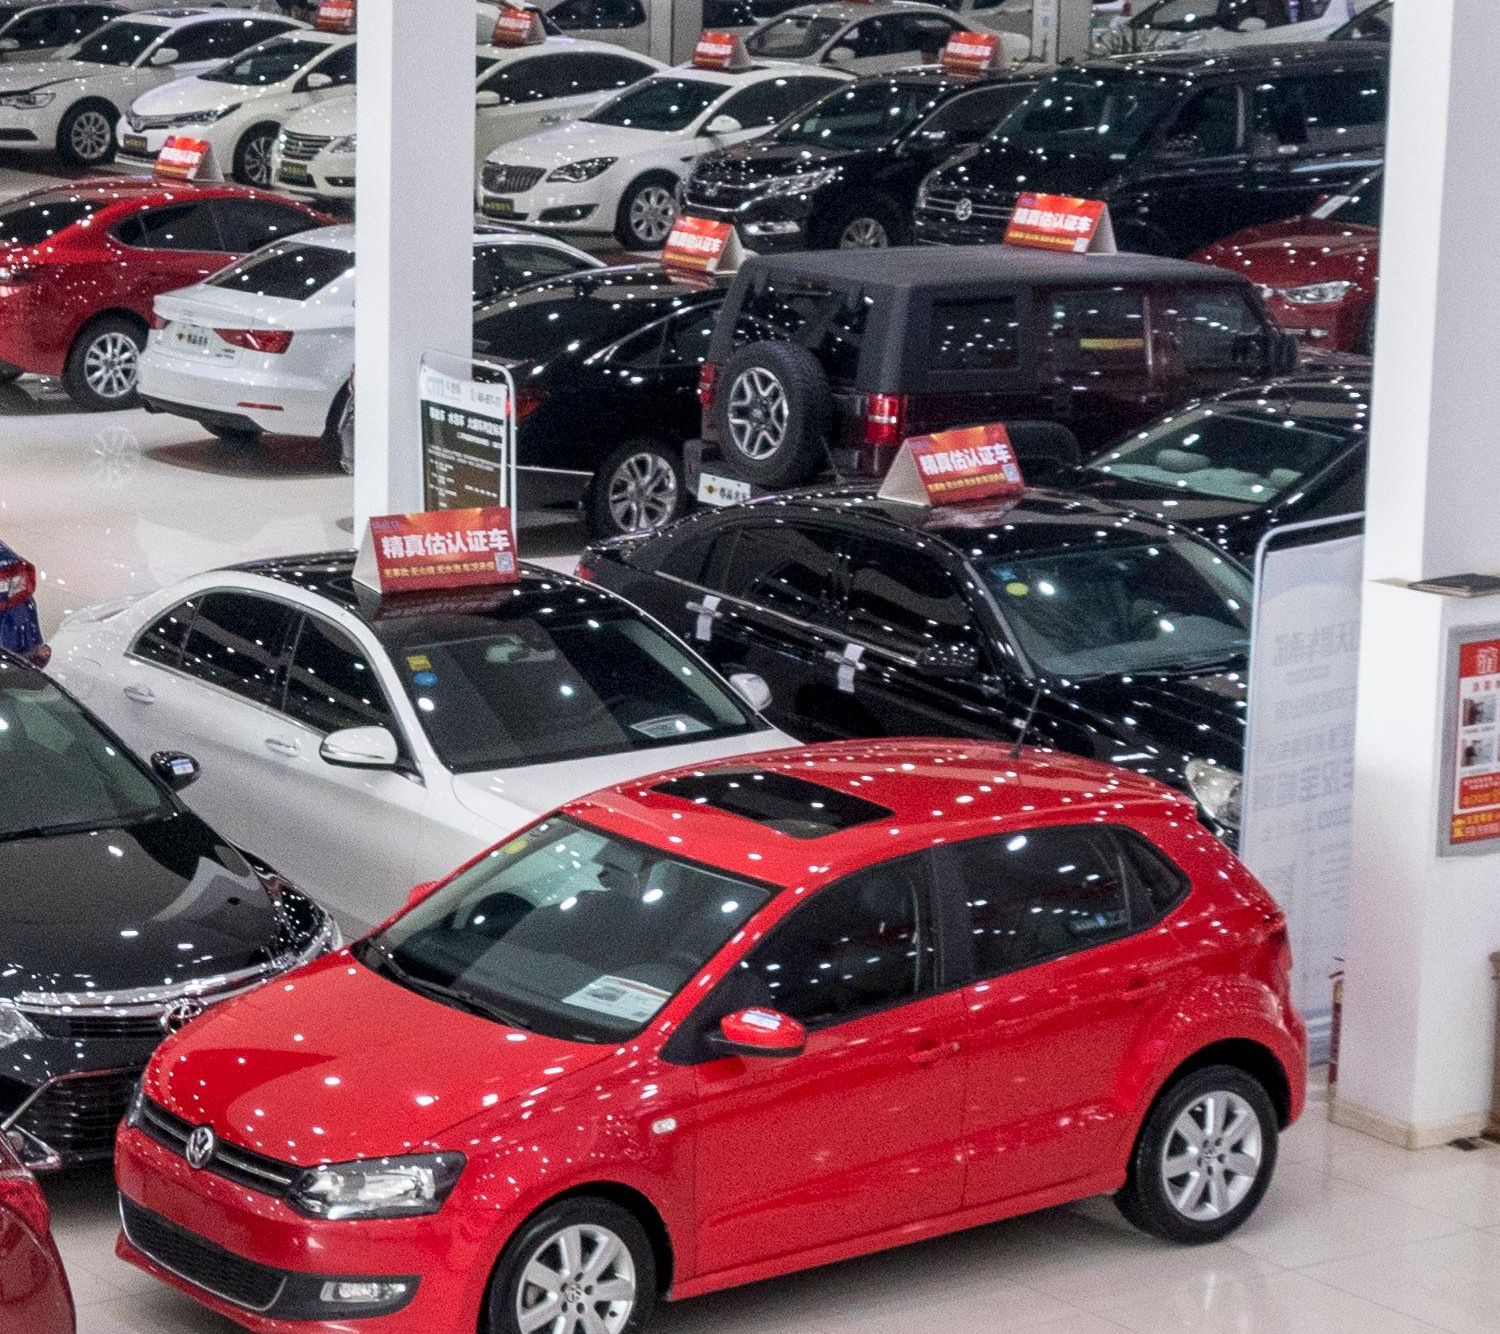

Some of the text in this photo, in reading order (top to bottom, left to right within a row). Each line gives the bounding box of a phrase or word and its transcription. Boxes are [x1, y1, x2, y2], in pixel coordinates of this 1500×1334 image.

[381, 528, 511, 560] 精真估认证车
